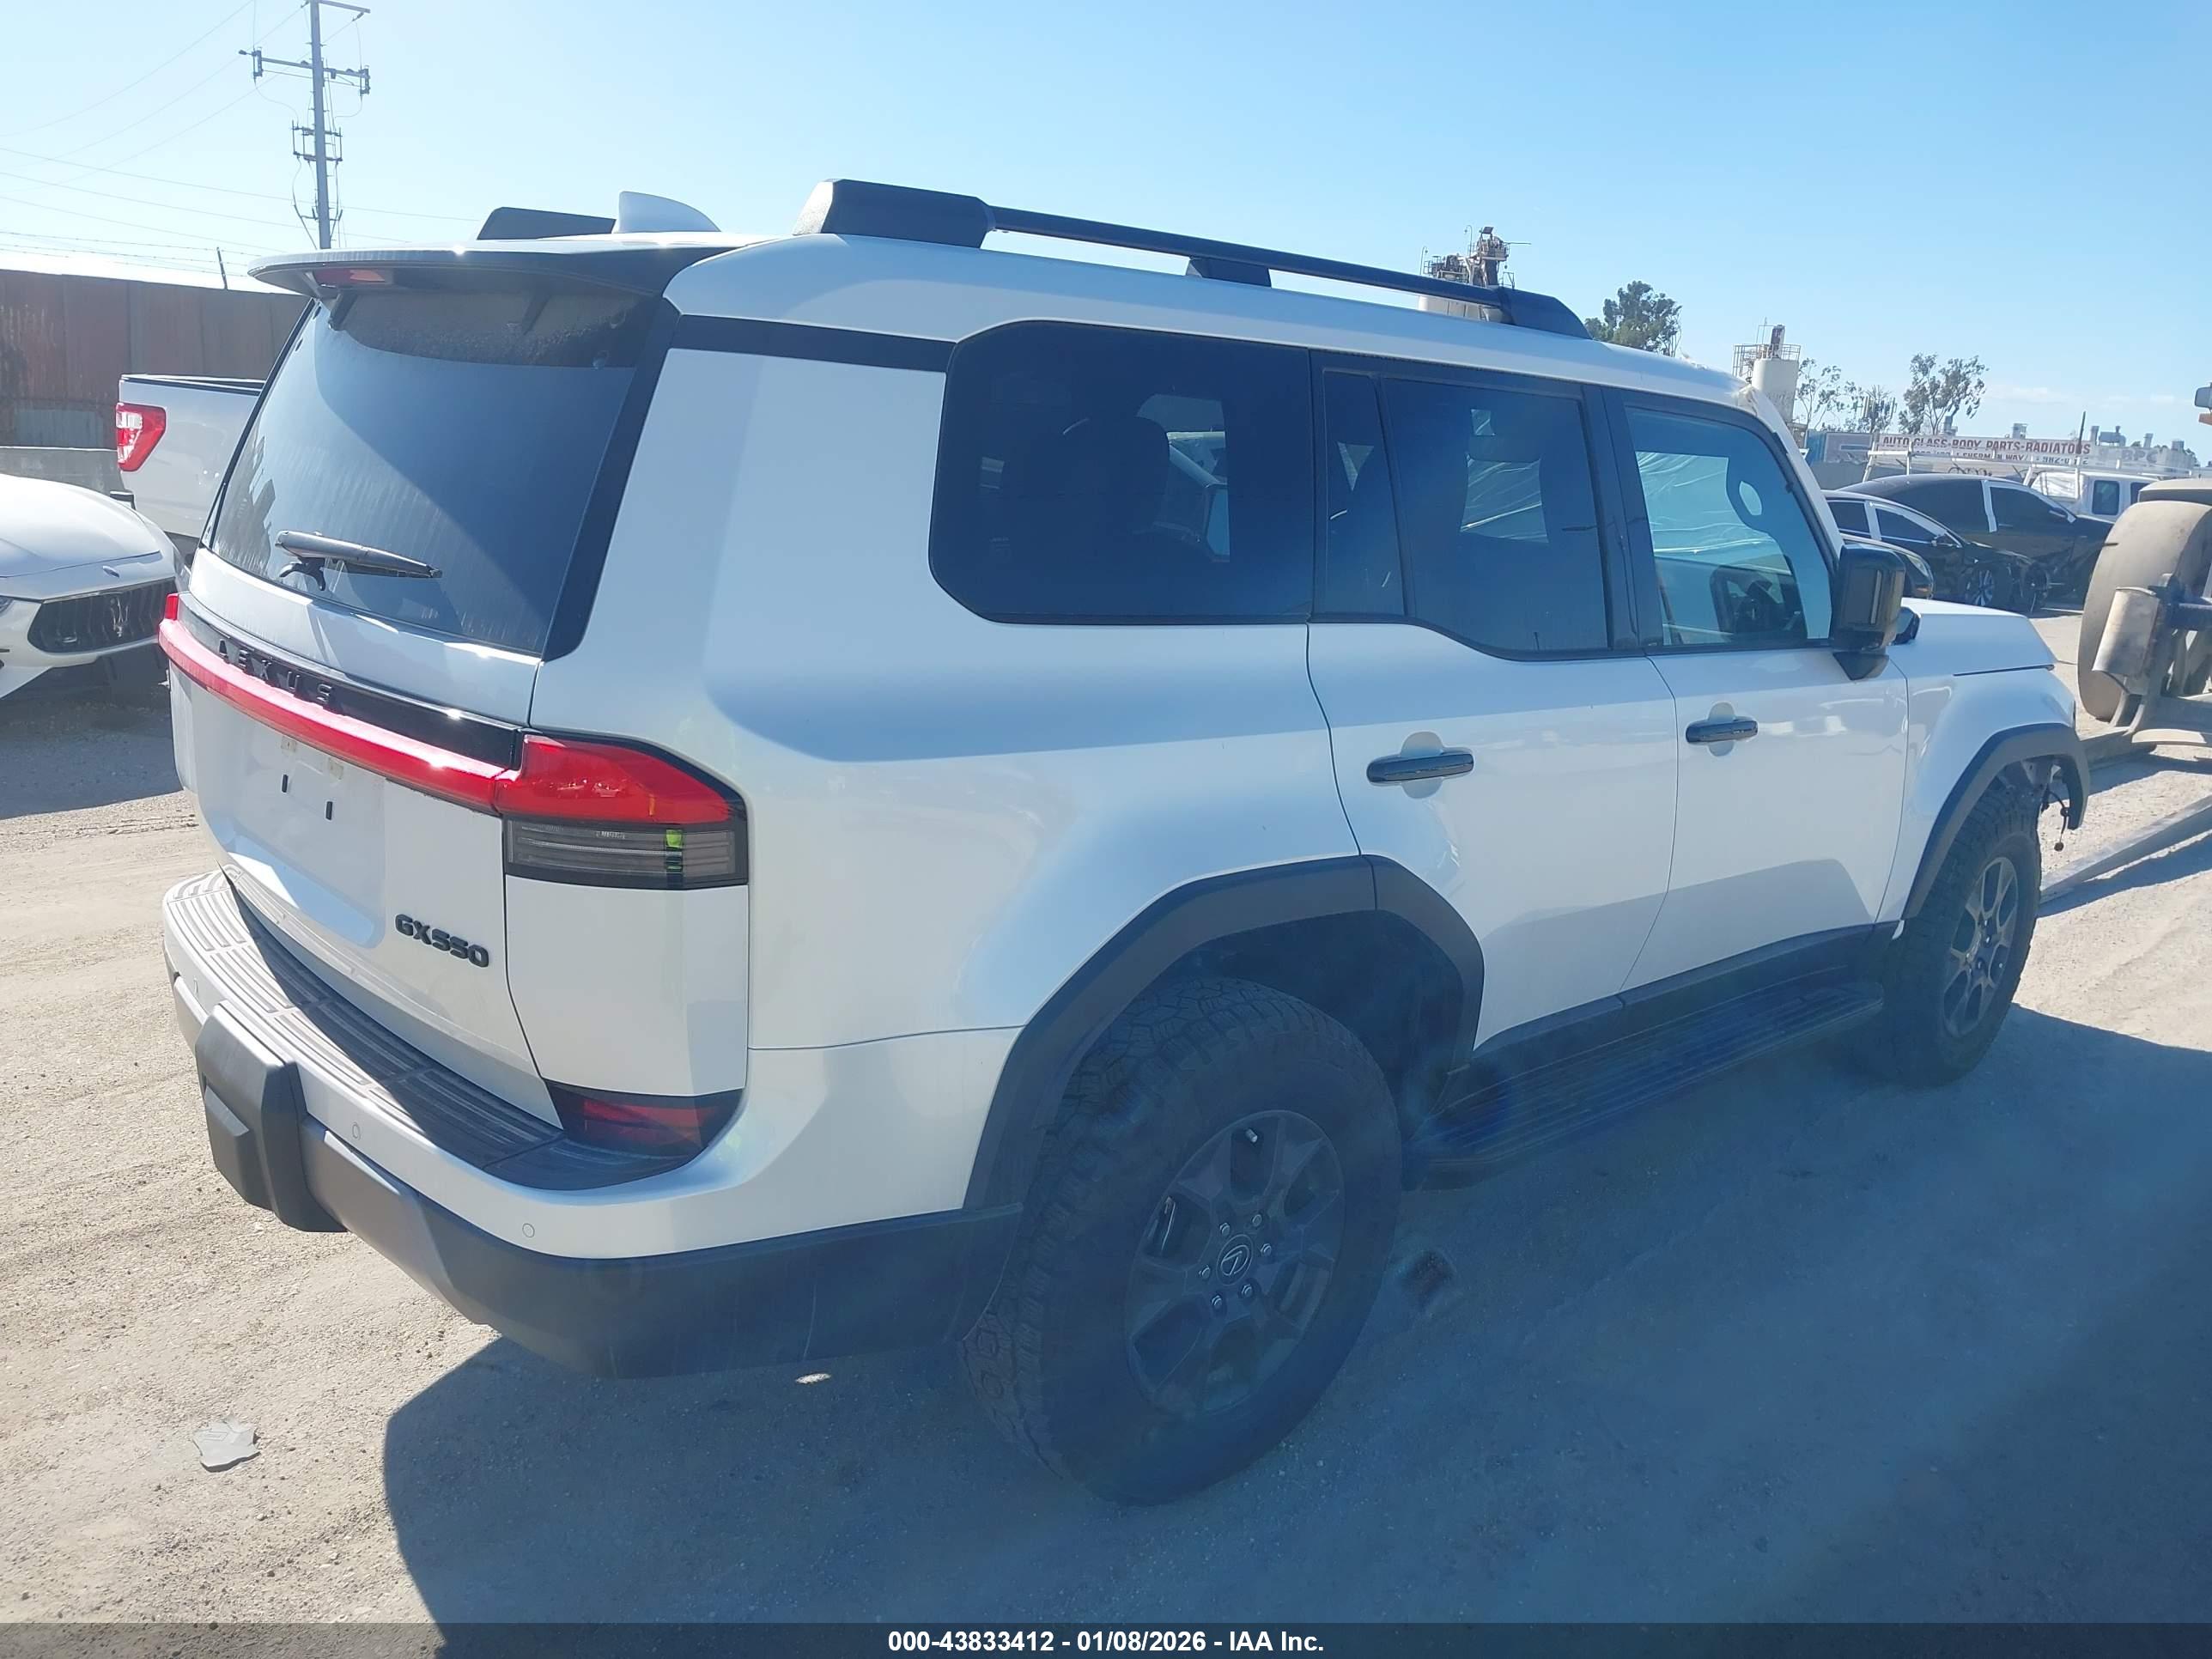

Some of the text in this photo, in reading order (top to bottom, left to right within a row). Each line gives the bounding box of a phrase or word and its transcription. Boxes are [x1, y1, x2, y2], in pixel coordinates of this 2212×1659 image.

[1882, 436, 1910, 447] AUTO
[218, 638, 333, 705] LEXUS
[395, 914, 489, 968] GX550
